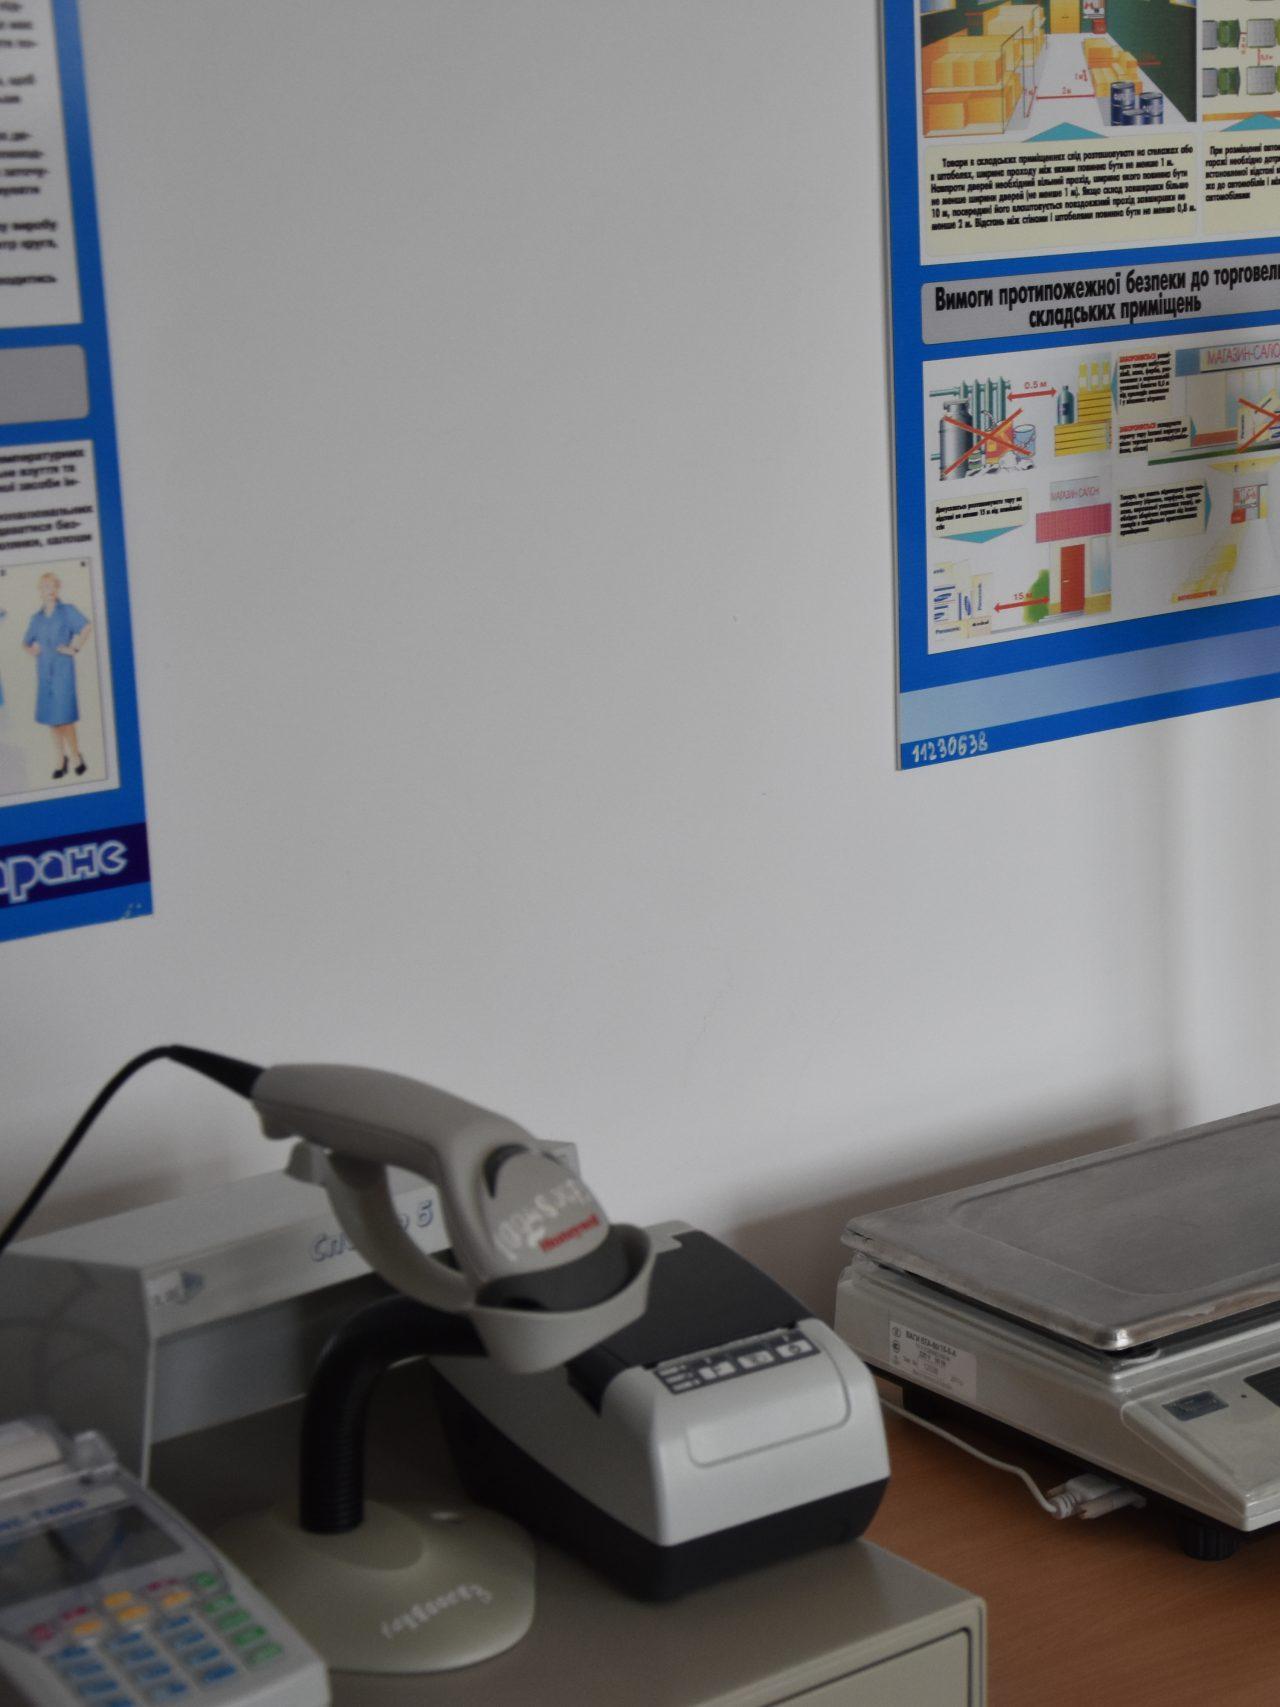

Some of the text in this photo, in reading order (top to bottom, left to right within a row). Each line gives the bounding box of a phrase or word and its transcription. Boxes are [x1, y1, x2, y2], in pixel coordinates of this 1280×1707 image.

[935, 283, 994, 312] Вимоги
[999, 272, 1122, 310] протипожежної
[1126, 268, 1188, 300] безпеки
[1190, 271, 1210, 293] до
[1028, 293, 1202, 330] складських приміщень
